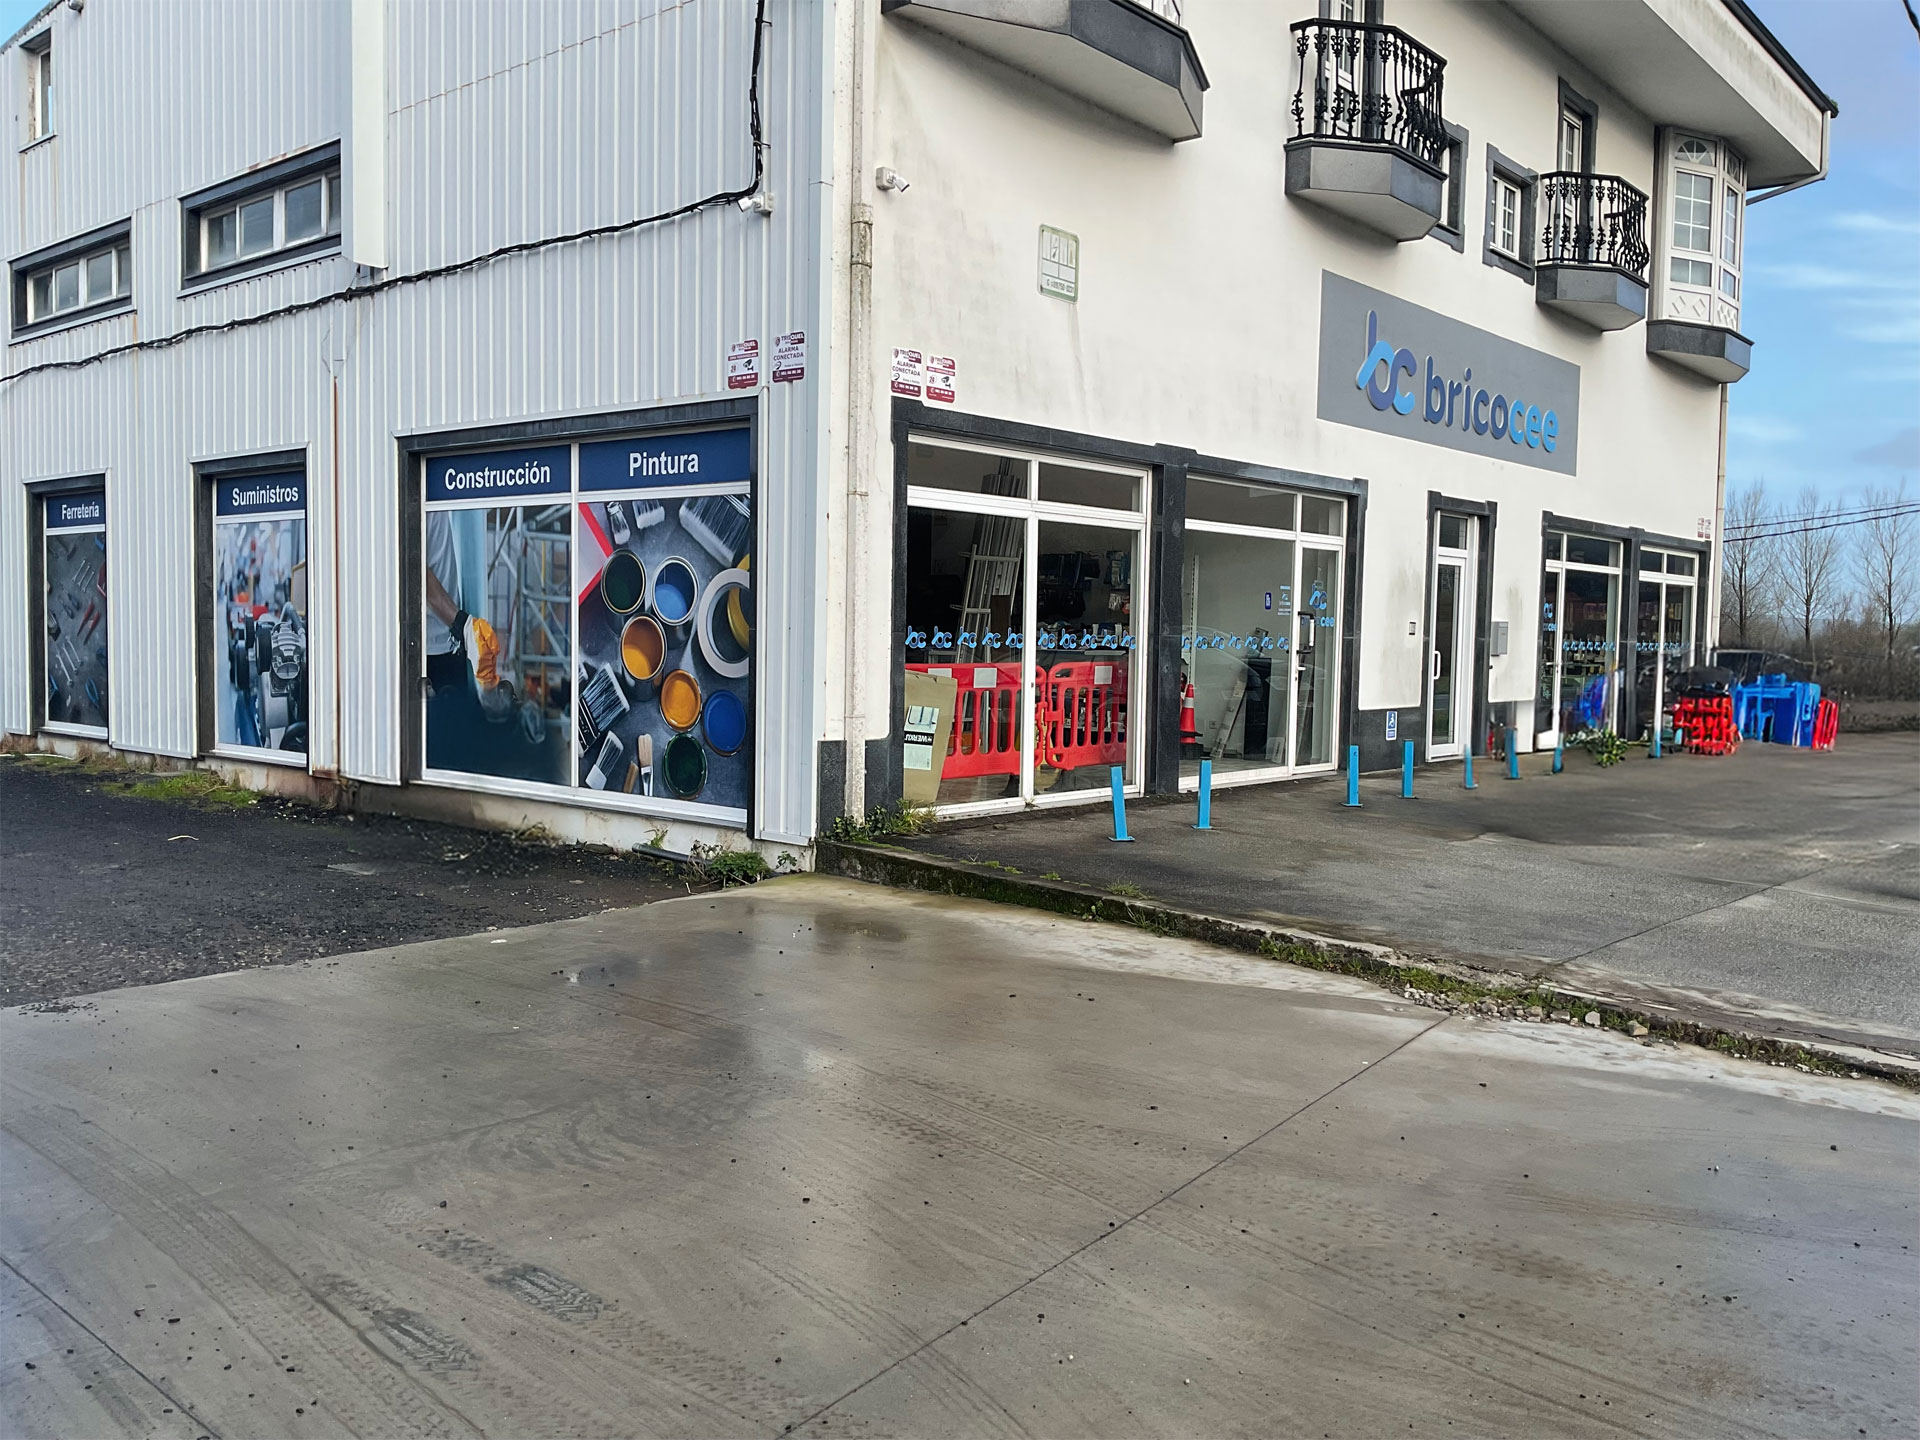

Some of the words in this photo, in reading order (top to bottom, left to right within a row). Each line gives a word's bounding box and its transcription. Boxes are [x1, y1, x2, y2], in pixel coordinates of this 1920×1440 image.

[773, 352, 804, 361] CONECTADA
[778, 346, 799, 354] ALARMA
[892, 366, 921, 377] CONECTADA
[897, 360, 916, 369] ALARMA
[1423, 355, 1559, 453] bricocee
[629, 451, 699, 477] Pintura
[444, 461, 551, 490] Construcción
[232, 486, 299, 507] Suministros
[61, 501, 100, 521] Ferretería
